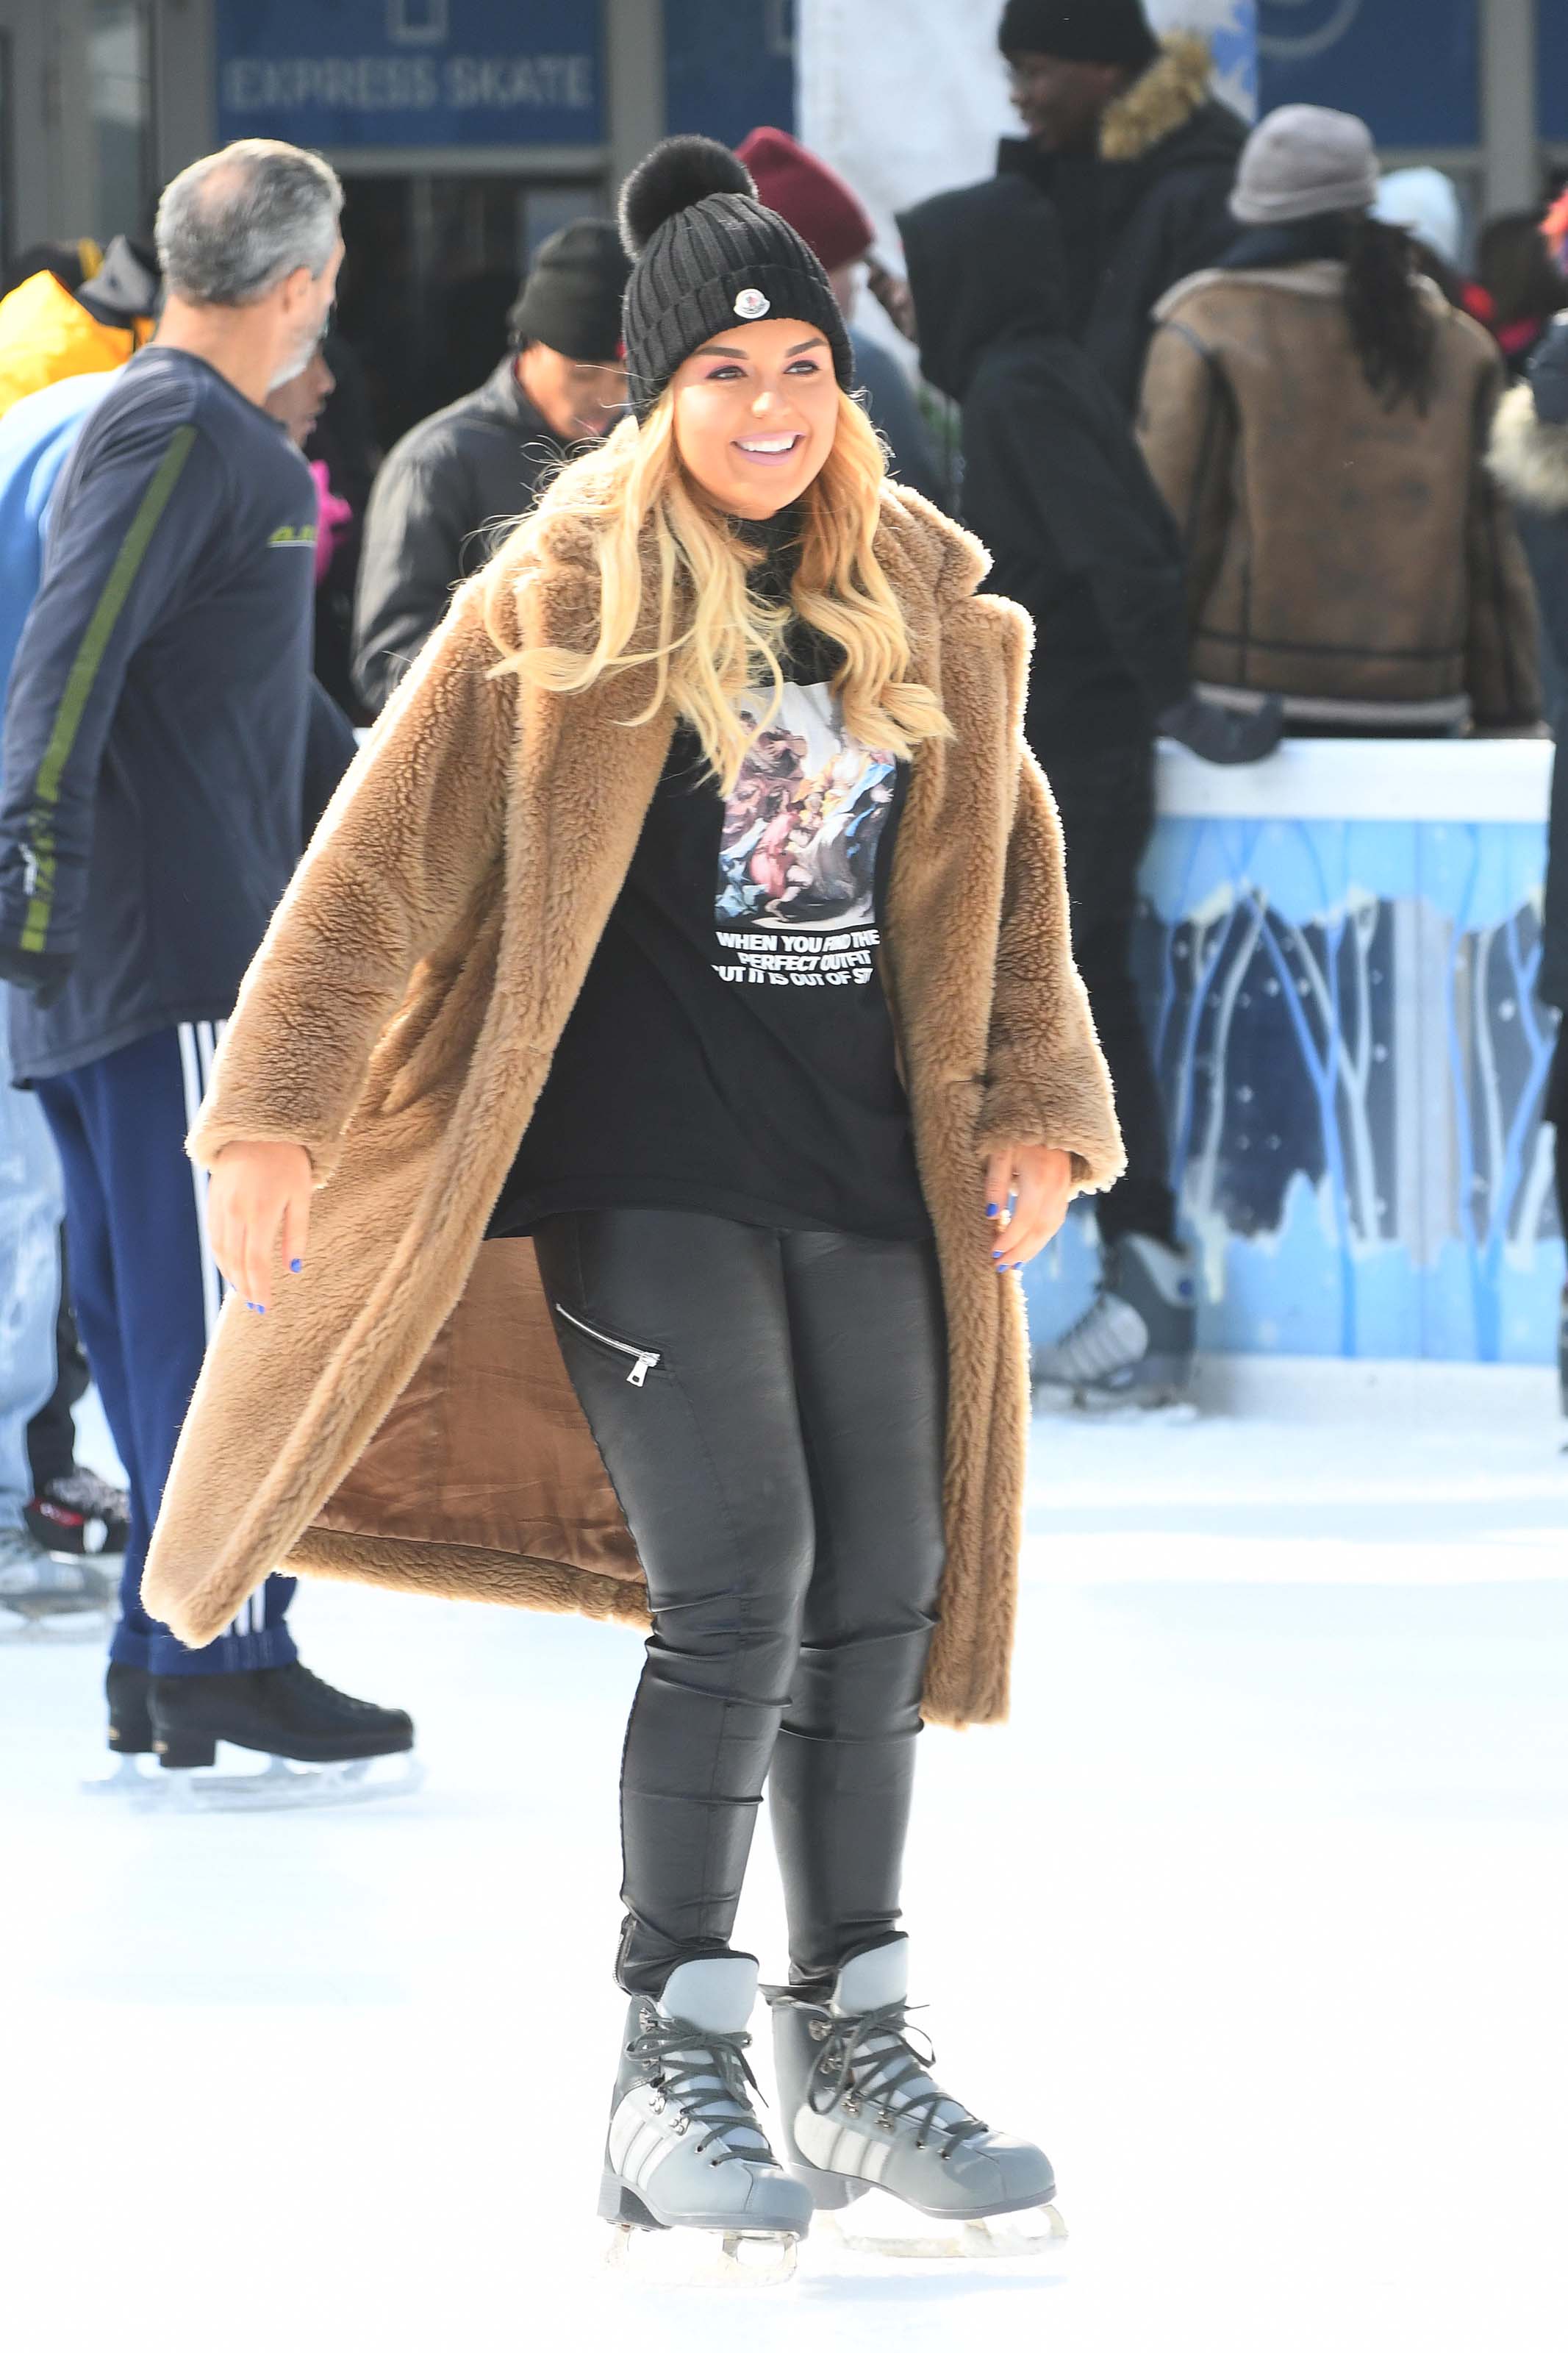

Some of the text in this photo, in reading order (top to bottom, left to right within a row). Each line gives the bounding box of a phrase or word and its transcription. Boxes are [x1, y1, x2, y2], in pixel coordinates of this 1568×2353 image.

[224, 54, 591, 110] EXPRESS SKATE
[715, 929, 881, 954] WHEN YOU FD THE
[737, 949, 872, 971] PERFECT OUTFIT
[710, 964, 746, 982] UT
[748, 967, 765, 984] IT
[767, 971, 790, 985] IS
[789, 972, 825, 986] OUT
[825, 971, 852, 985] OF
